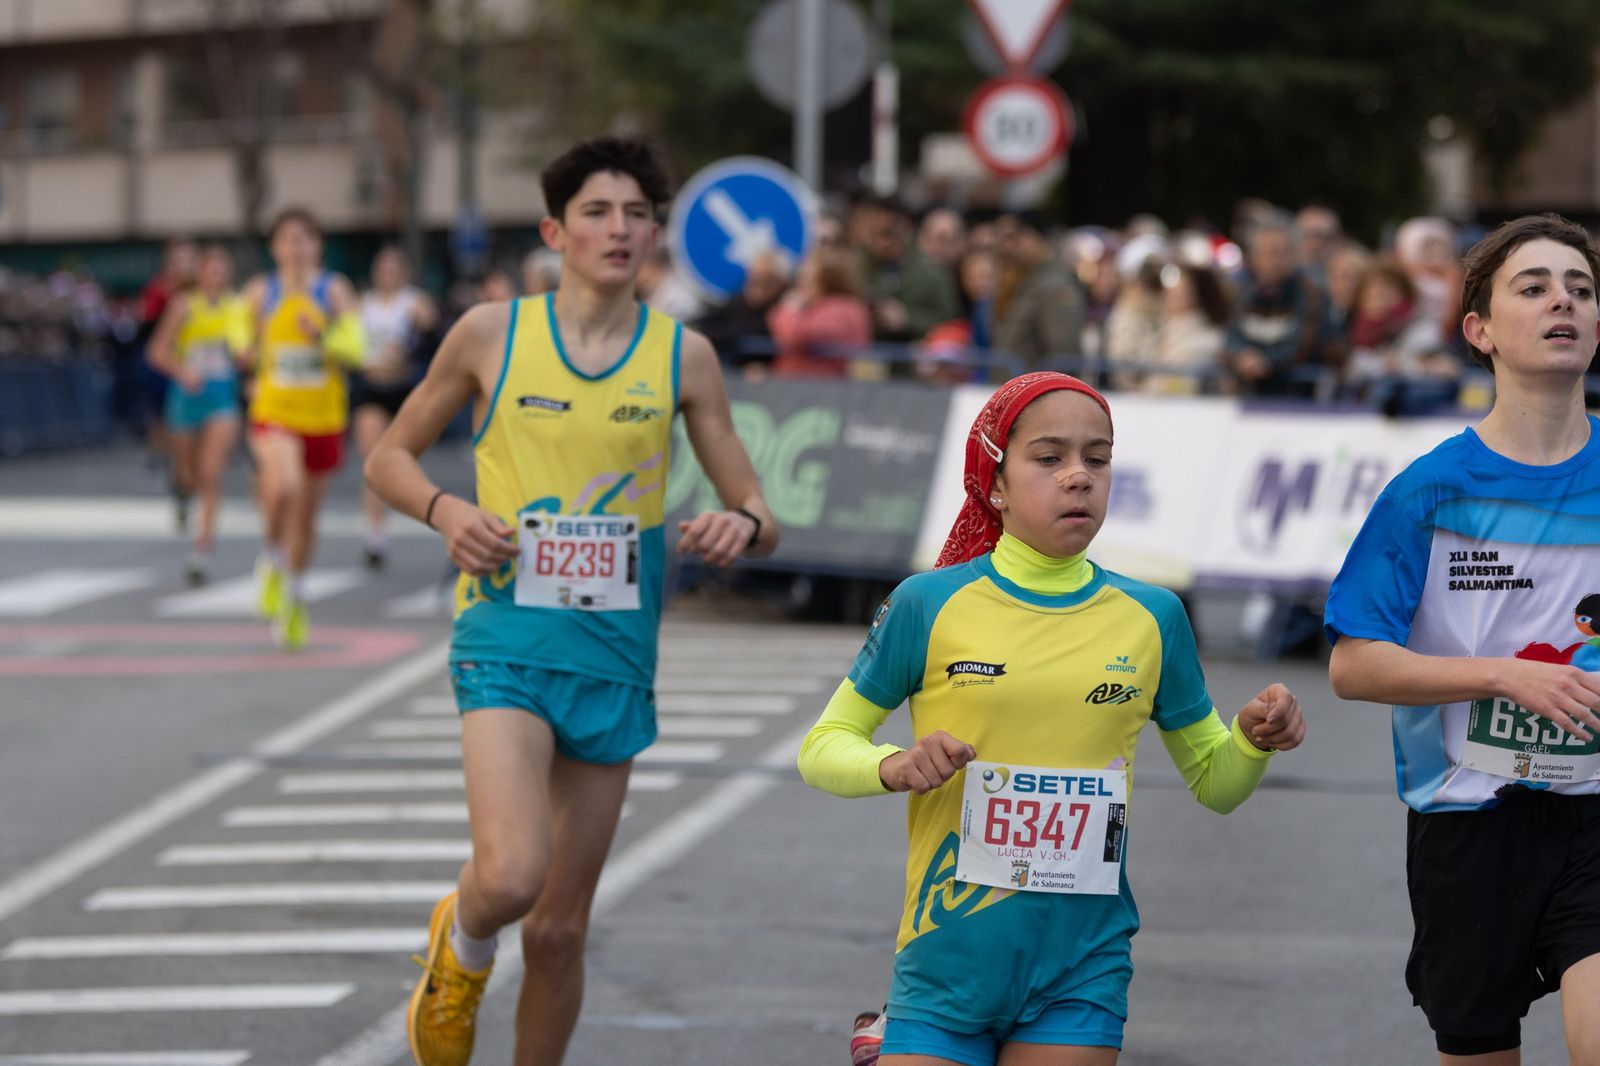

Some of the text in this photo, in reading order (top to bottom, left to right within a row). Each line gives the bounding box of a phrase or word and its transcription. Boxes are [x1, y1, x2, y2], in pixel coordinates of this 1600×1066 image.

[536, 540, 615, 577] 6239
[1449, 551, 1499, 562] XLI SAN
[1449, 565, 1514, 576] SILVESTRE
[1449, 579, 1534, 591] SALMANTINA
[953, 663, 995, 675] ALJOMAR
[1105, 664, 1137, 673] amura
[1524, 744, 1551, 754] GAEL
[1533, 763, 1574, 772] Ayuntamiento
[1541, 772, 1573, 780] Salamanca
[1013, 773, 1113, 797] SETEL
[984, 797, 1091, 850] 6347
[1031, 869, 1076, 880] Ayuntamiento
[1031, 880, 1075, 889] de Salamanca
